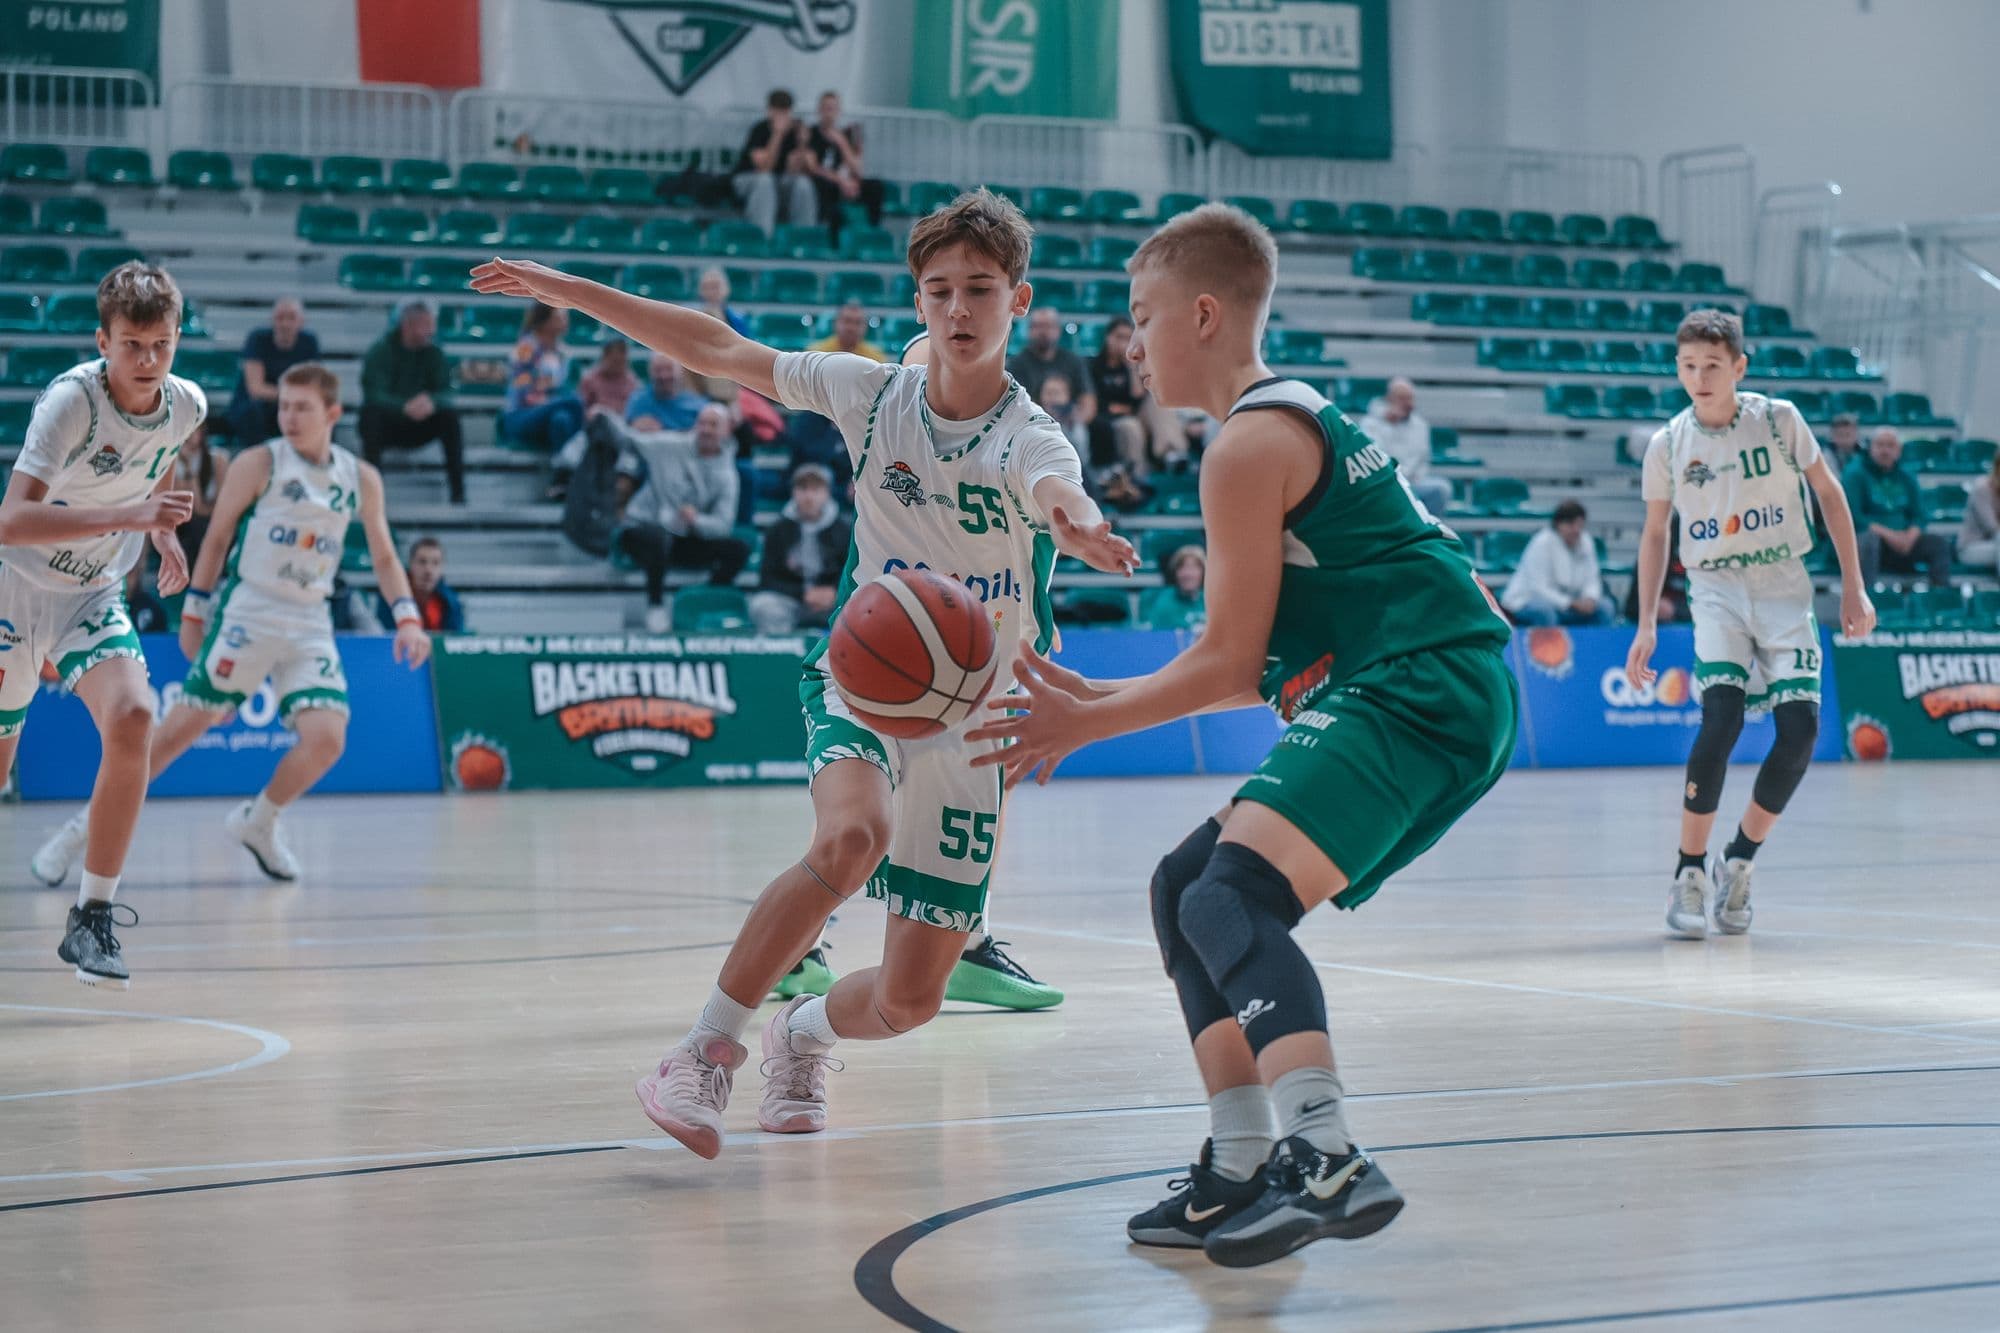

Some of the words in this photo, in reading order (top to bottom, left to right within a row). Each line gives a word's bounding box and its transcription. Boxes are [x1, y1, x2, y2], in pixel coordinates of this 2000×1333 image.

[28, 6, 128, 32] POLAND
[1208, 20, 1353, 59] DIGITAL
[1738, 446, 1771, 479] 10
[1689, 518, 1719, 541] Q8
[1743, 504, 1783, 531] Oils
[531, 660, 737, 717] BASKETBALL
[939, 805, 998, 864] 55
